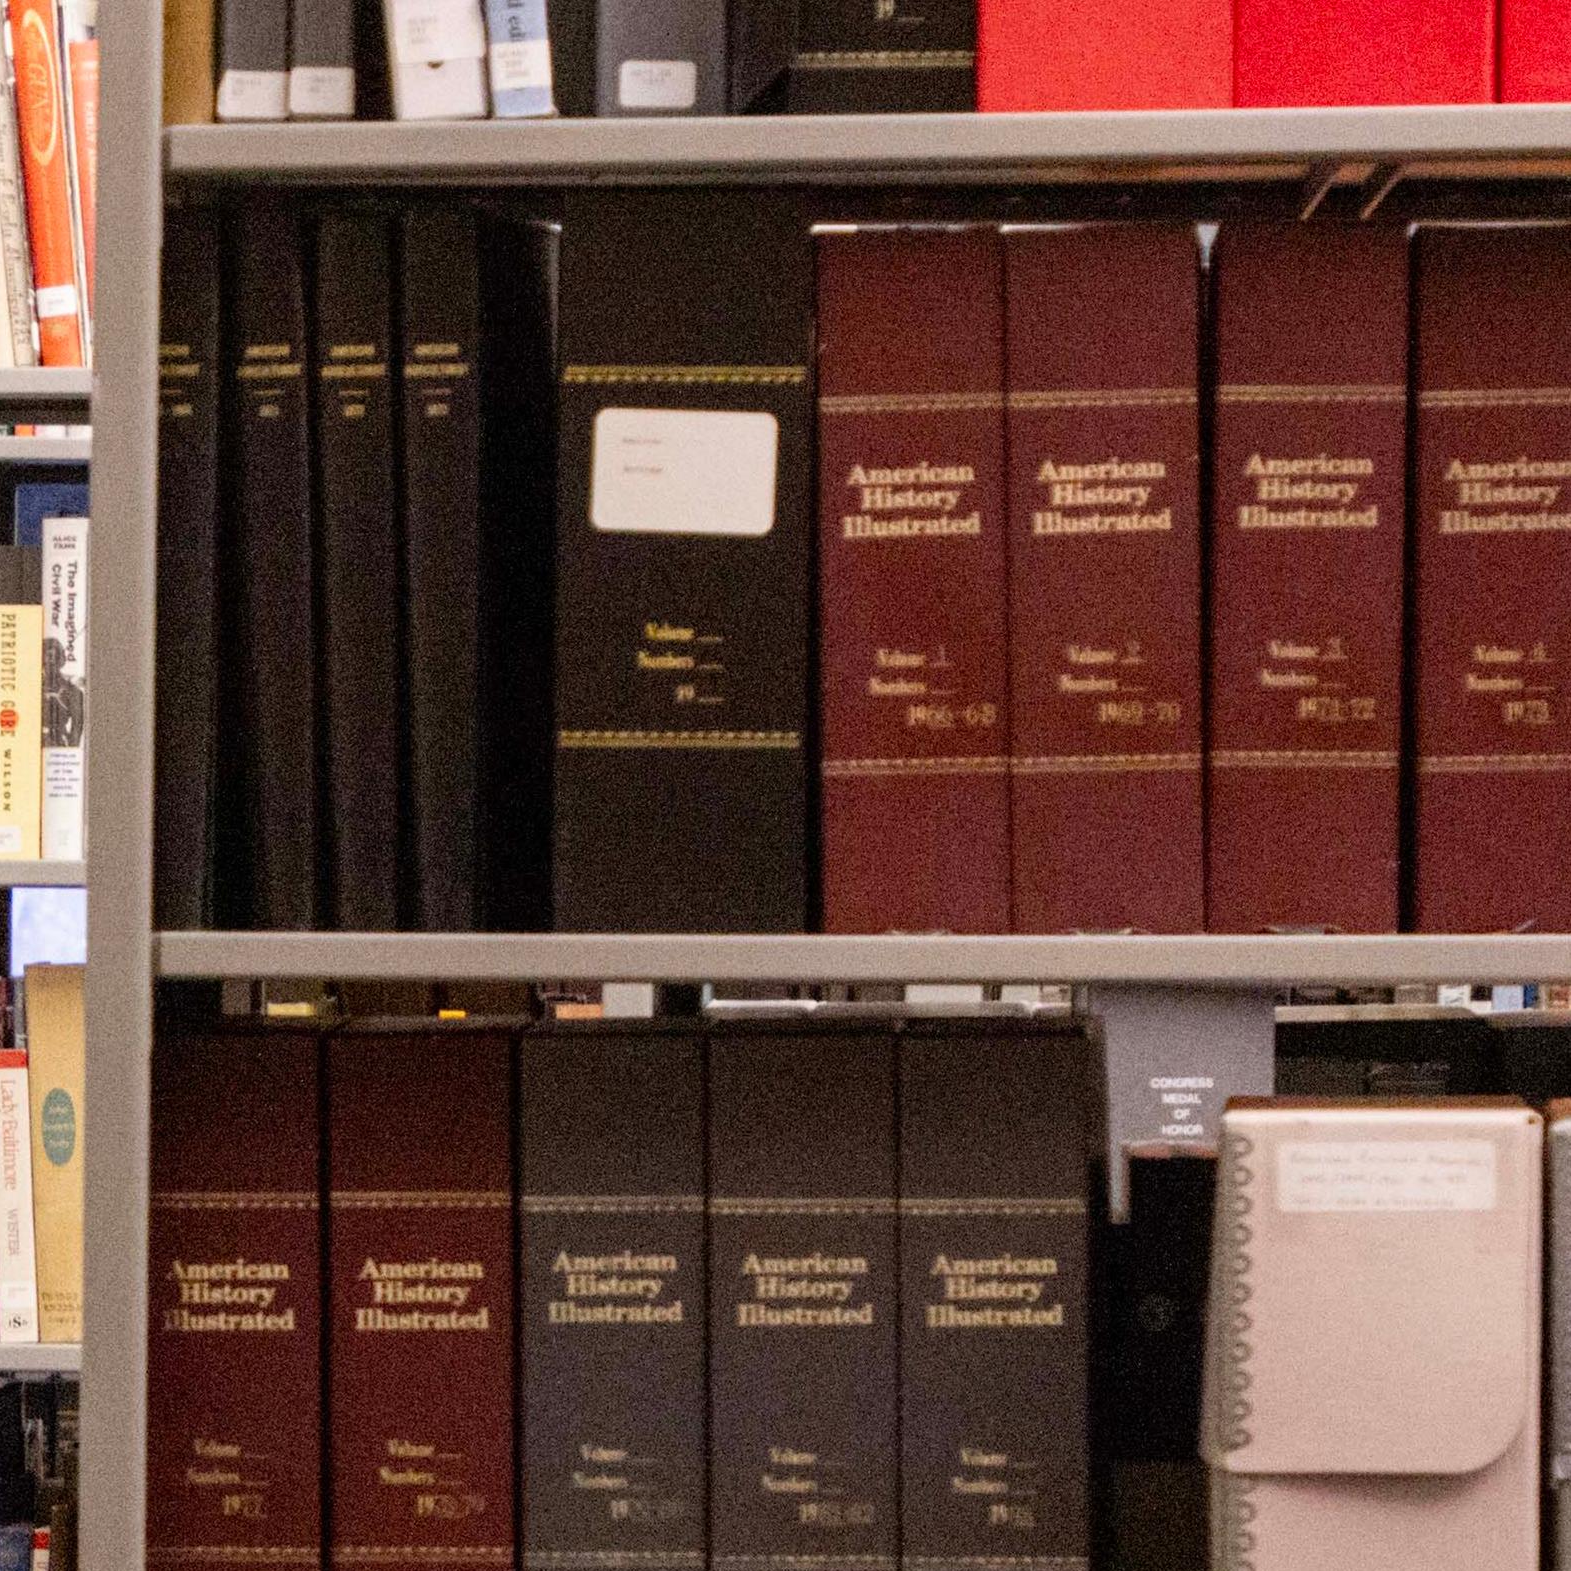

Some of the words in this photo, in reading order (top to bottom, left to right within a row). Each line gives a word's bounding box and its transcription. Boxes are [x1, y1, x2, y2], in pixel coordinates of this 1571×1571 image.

[847, 462, 975, 486] American
[1038, 459, 1166, 481] American
[1244, 454, 1373, 477] American
[861, 485, 962, 511] History
[1050, 481, 1151, 507] History
[1256, 477, 1358, 503] History
[1459, 480, 1559, 506] History
[842, 513, 981, 539] Illustrated
[1032, 509, 1172, 534] Illustrated
[1239, 506, 1378, 529] Illustrated
[51, 564, 61, 596] Civil
[67, 561, 78, 589] The
[51, 600, 61, 628] War
[63, 592, 77, 662] Imagined
[0, 612, 16, 692] PATRIOTIC
[0, 700, 17, 738] GORE
[3, 749, 11, 812] WILSON
[1149, 1077, 1214, 1089] CONGRESS
[0, 1079, 17, 1118] Lady
[1174, 1109, 1190, 1120] OF
[1161, 1124, 1204, 1136] HONOR
[3, 1120, 21, 1190] Baltimore
[170, 1258, 290, 1281] American
[359, 1257, 483, 1280] American
[552, 1250, 677, 1273] American
[742, 1252, 869, 1275] American
[931, 1253, 1058, 1276] American
[180, 1282, 277, 1306] History
[373, 1282, 471, 1305] History
[566, 1275, 664, 1298] History
[755, 1278, 852, 1300] History
[945, 1278, 1044, 1301] History
[164, 1309, 295, 1332] Illustrated
[356, 1308, 489, 1331] Illustrated
[548, 1302, 683, 1323] Illustrated
[736, 1303, 873, 1326] Illustrated
[926, 1304, 1063, 1328] Illustrated
